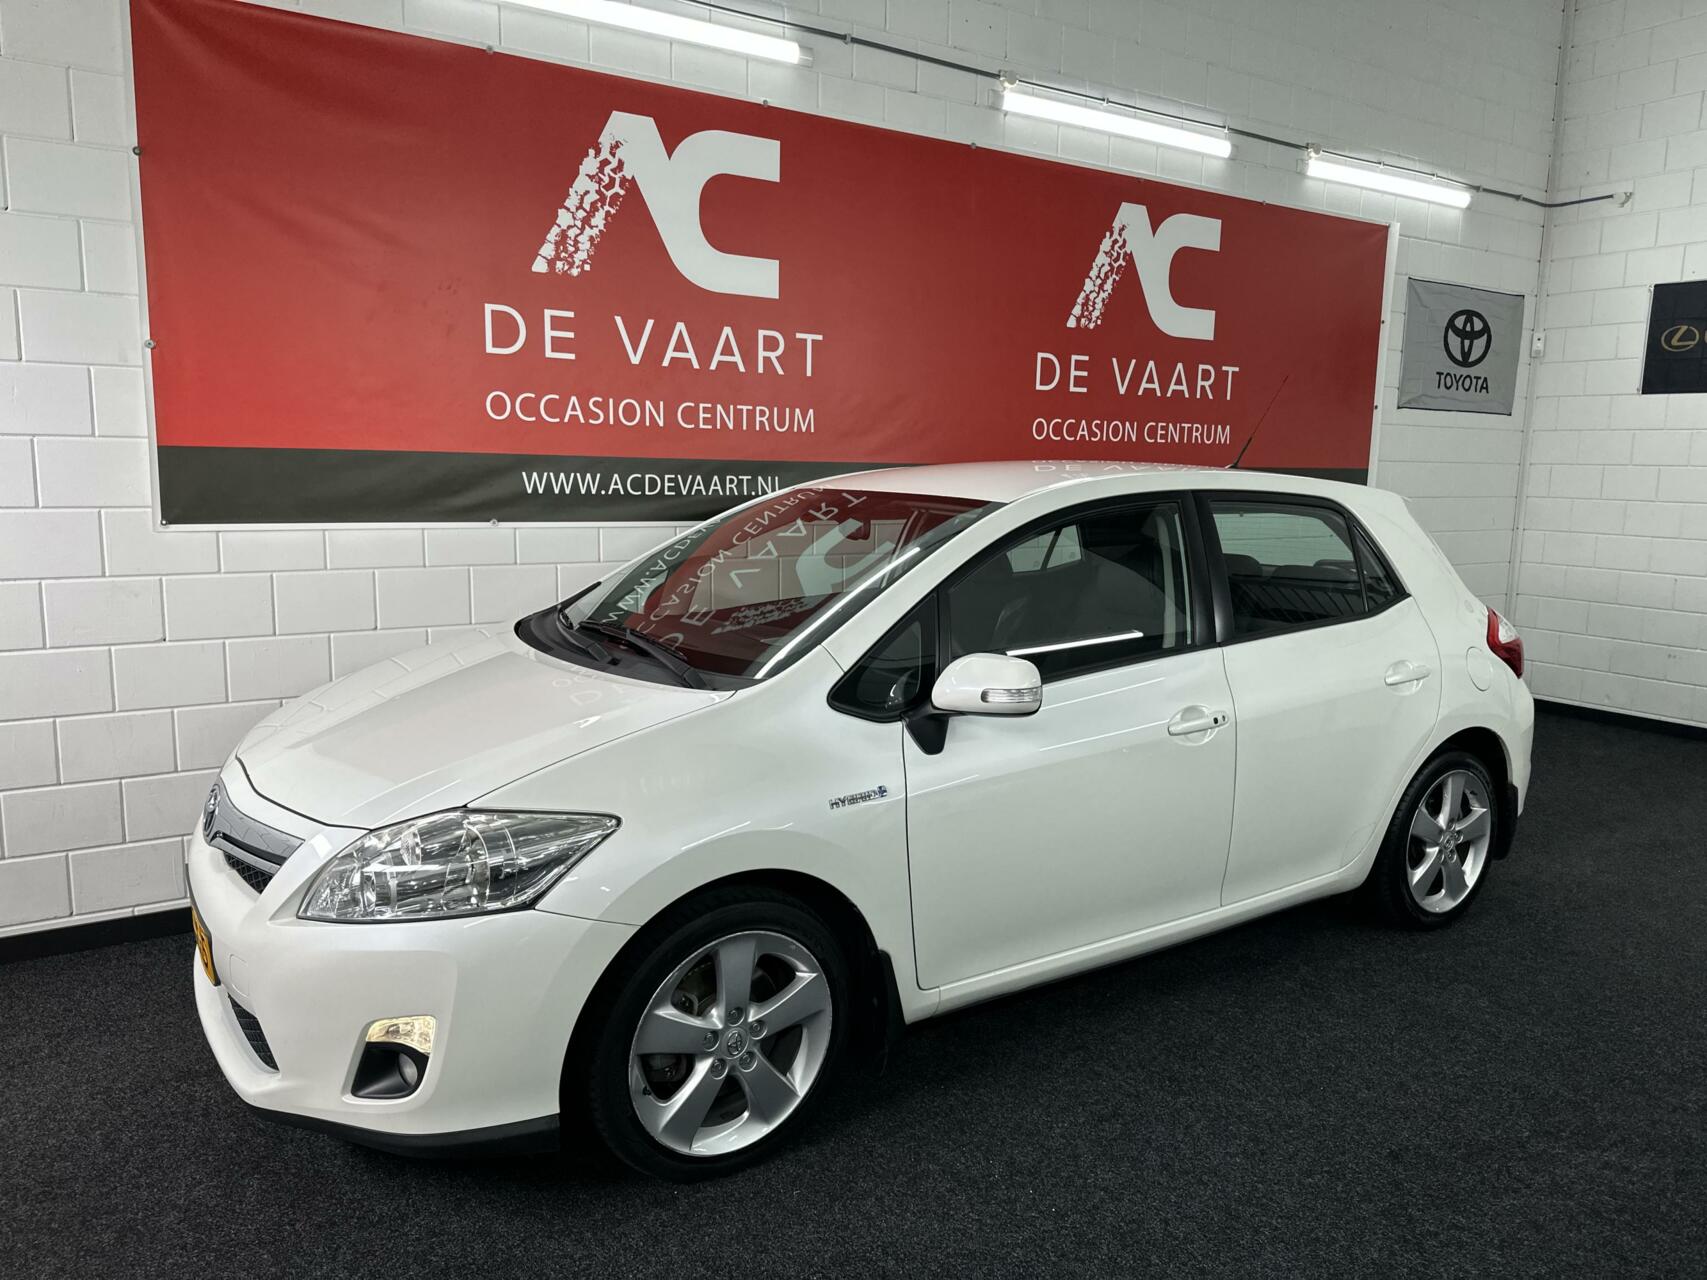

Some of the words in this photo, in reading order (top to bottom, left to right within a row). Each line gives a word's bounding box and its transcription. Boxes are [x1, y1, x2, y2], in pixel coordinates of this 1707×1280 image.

[485, 303, 576, 359] DE
[614, 316, 823, 376] VAART
[1036, 352, 1089, 392] DE
[1112, 358, 1239, 400] VAART
[1436, 372, 1489, 394] TOYOTA
[486, 391, 664, 427] OCCASION
[677, 402, 814, 432] CENTRUM
[1033, 418, 1136, 442] OCCASION
[1145, 422, 1230, 444] CENTRUM
[829, 789, 877, 810] HYBRID
